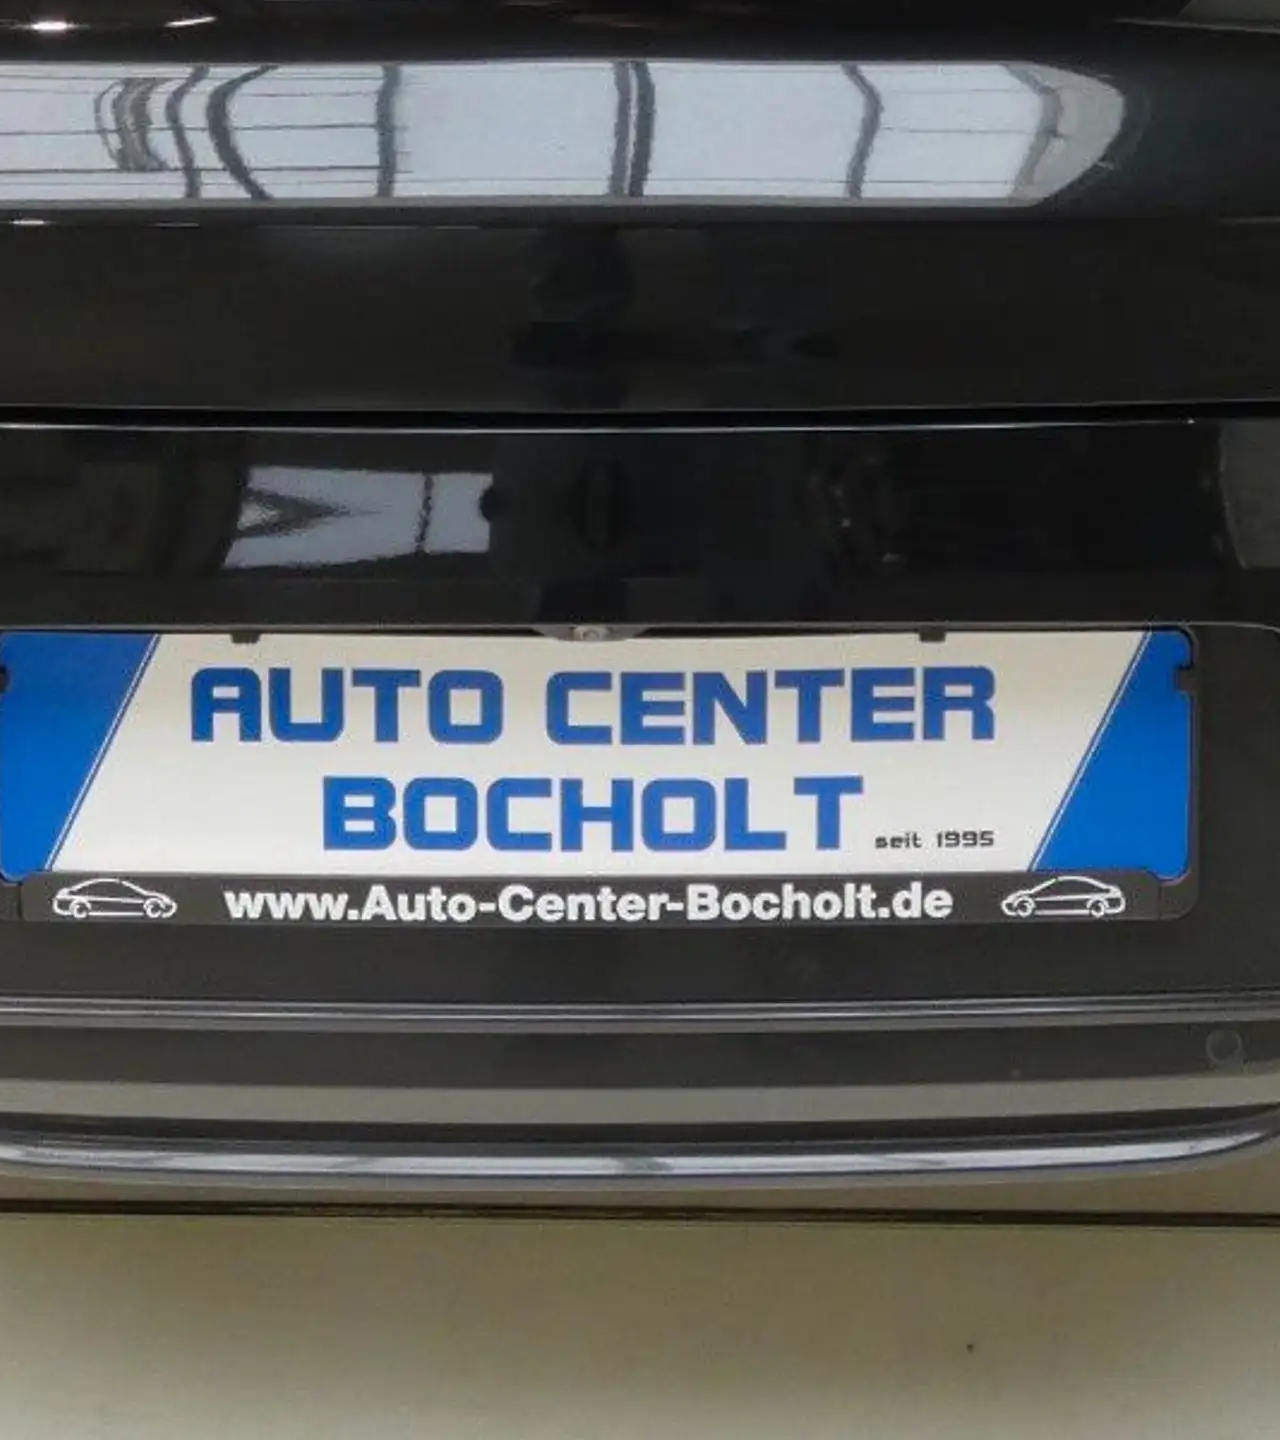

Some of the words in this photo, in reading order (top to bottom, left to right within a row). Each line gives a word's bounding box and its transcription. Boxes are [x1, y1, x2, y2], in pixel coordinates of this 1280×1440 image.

[191, 667, 504, 744] AUTO
[545, 665, 996, 745] CENTER
[323, 775, 864, 852] BOCHOLT
[874, 830, 922, 849] seit
[936, 829, 995, 848] 1995
[223, 881, 955, 923] www.Auto-Center-Bocholt.de
